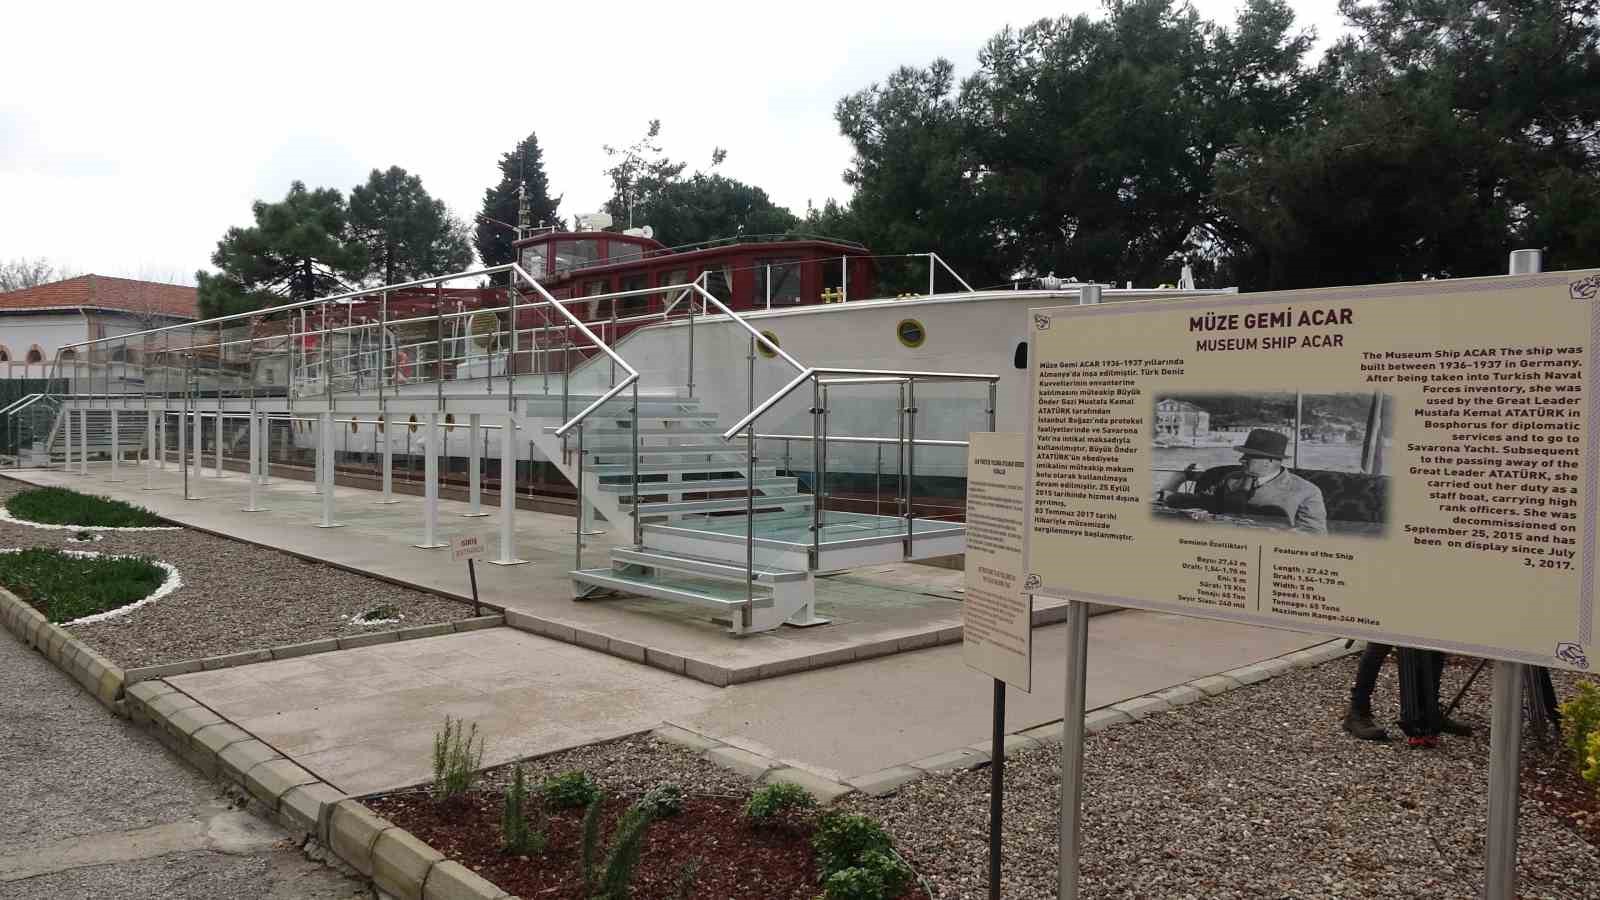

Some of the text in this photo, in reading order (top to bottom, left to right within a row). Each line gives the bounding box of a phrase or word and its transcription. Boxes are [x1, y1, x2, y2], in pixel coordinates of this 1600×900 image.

[1189, 307, 1352, 331] MÜZE GEMİ ACAR
[1196, 334, 1343, 351] MUSEUM SHIP ACAR
[1363, 352, 1382, 360] The
[1386, 351, 1432, 359] Museum
[1434, 350, 1460, 359] Ship
[1526, 348, 1553, 356] ship
[1505, 360, 1516, 368] in
[1520, 359, 1582, 370] Germany.
[1397, 375, 1428, 383] being
[1494, 372, 1540, 380] Turkish
[1464, 385, 1525, 394] inventory,
[1427, 397, 1581, 406] used by the Great Leader
[1415, 407, 1580, 417] Mustafa Kemal ATATÜRK in
[1425, 421, 1580, 432] Bosphorus for diplomatic
[1505, 434, 1528, 442] and
[1547, 436, 1560, 444] go
[1567, 435, 1579, 443] to
[1408, 444, 1460, 452] Savarona
[1503, 446, 1579, 457] Subsequent
[1434, 456, 1453, 464] the
[1456, 457, 1502, 467] passing
[1506, 460, 1538, 468] away
[1541, 460, 1554, 468] of
[1557, 460, 1578, 468] the
[1410, 467, 1578, 481] Great Leader ATATÜRK, she
[1428, 480, 1470, 489] carried
[1473, 482, 1492, 490] out
[1496, 482, 1517, 491] her
[1521, 484, 1548, 494] duty
[1430, 492, 1455, 500] staff
[1492, 495, 1545, 506] carrying
[1549, 498, 1577, 507] high
[1439, 504, 1576, 519] rank officers. She was
[1453, 516, 1576, 532] decommissioned on
[1404, 524, 1466, 536] September
[1493, 531, 1522, 540] 2015
[1526, 534, 1549, 543] and
[1553, 536, 1576, 544] has
[1414, 537, 1441, 546] been
[1465, 541, 1508, 552] display
[1512, 544, 1544, 554] since
[1548, 547, 1575, 558] July
[1539, 559, 1574, 570] 2017.
